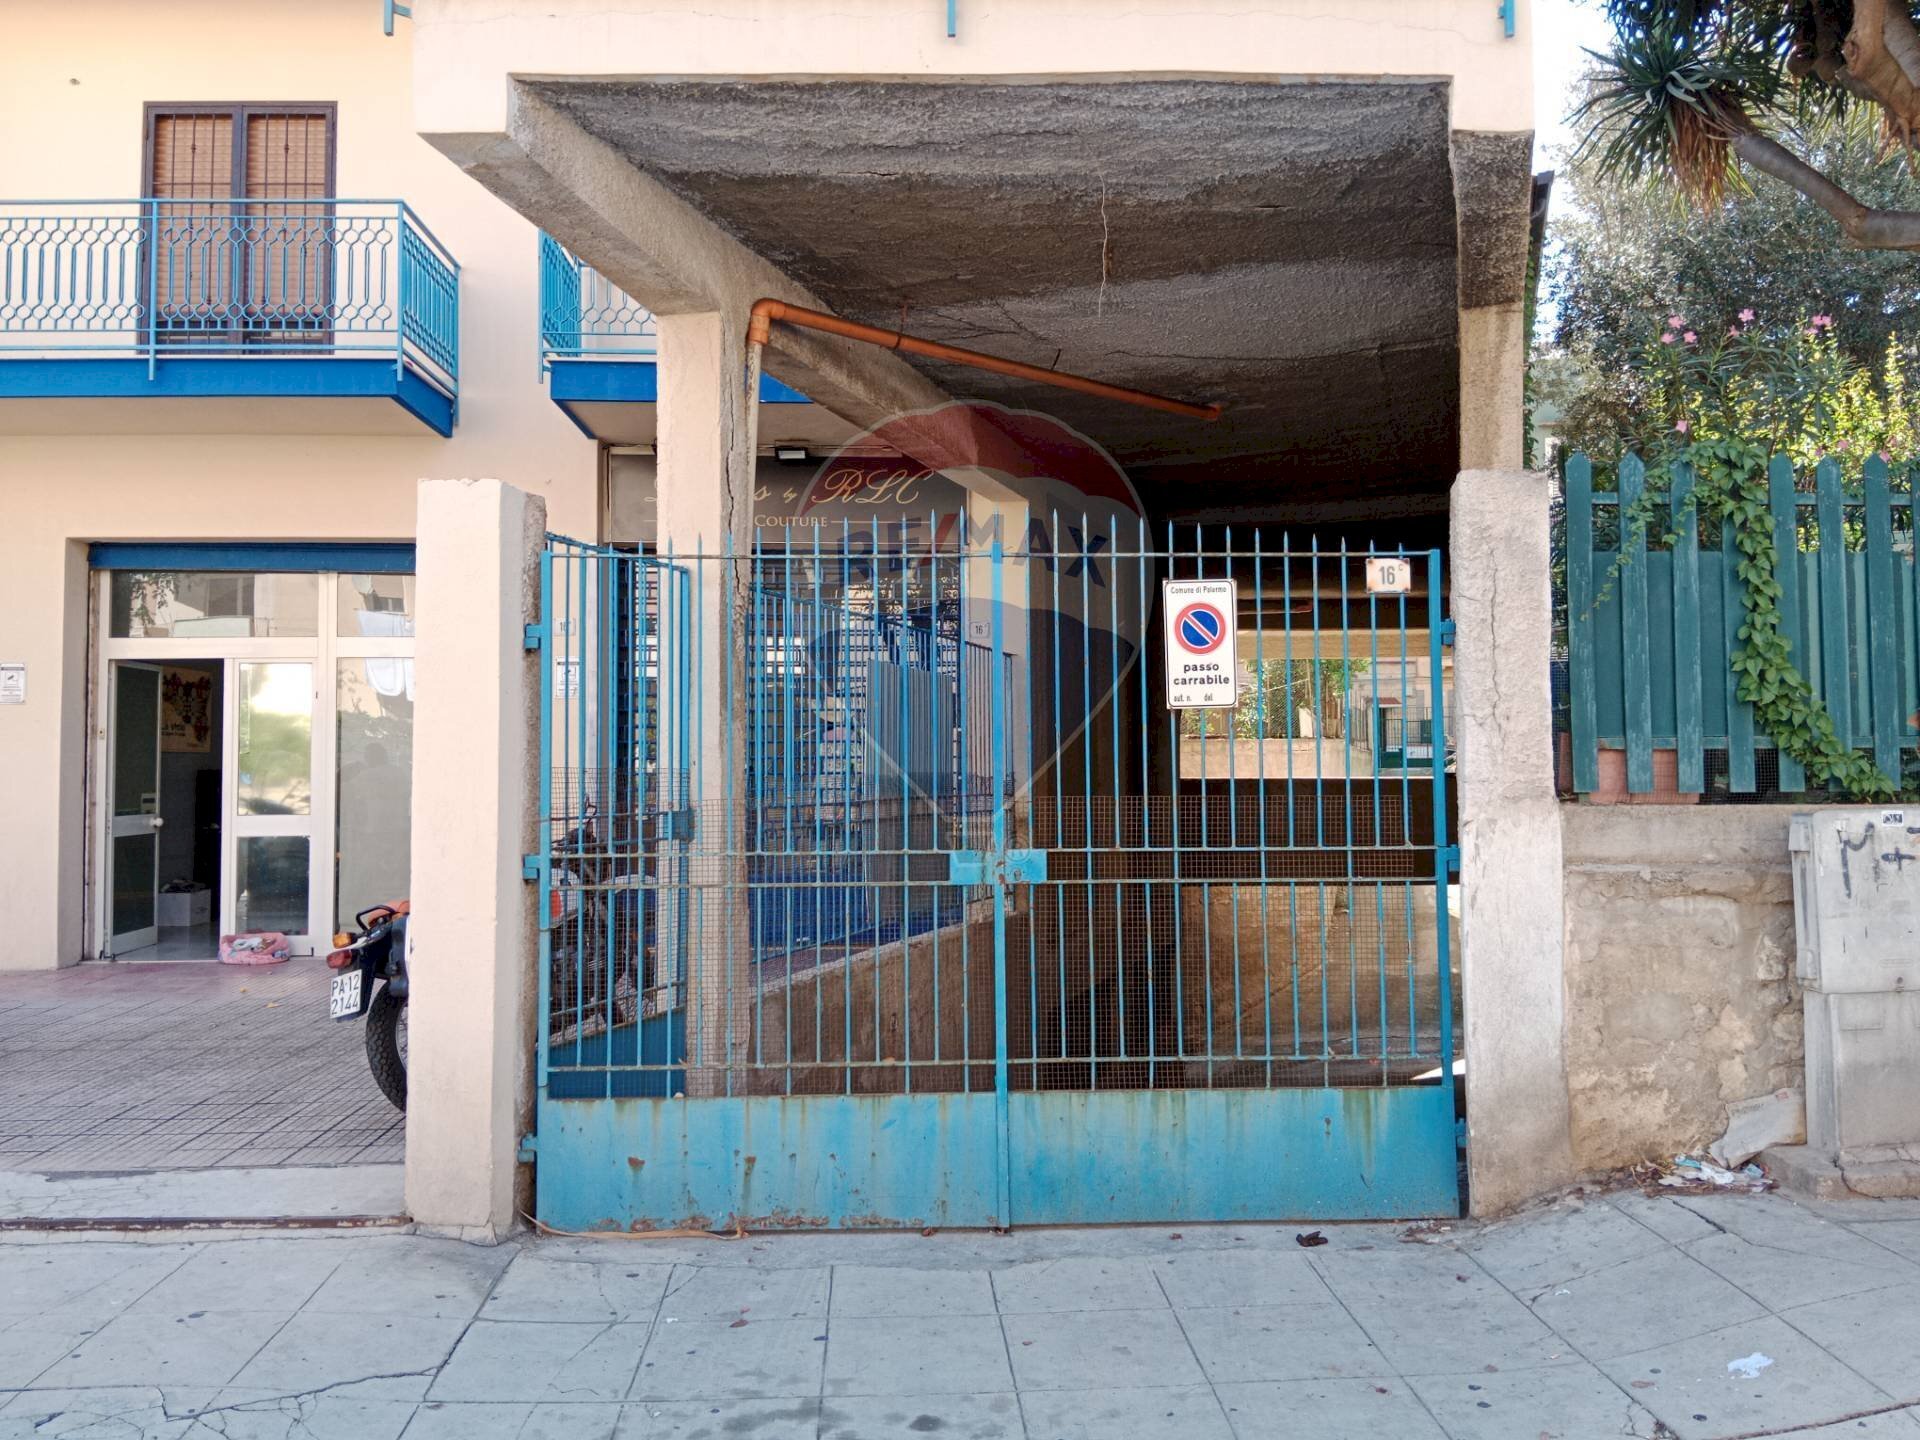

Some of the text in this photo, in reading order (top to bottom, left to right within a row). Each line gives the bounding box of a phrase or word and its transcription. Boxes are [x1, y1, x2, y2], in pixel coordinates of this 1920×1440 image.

[1170, 586, 1194, 594] Comune
[1203, 586, 1228, 594] Palermo
[1183, 663, 1220, 674] passo
[1173, 674, 1230, 685] carrabile
[331, 992, 359, 1015] 2144
